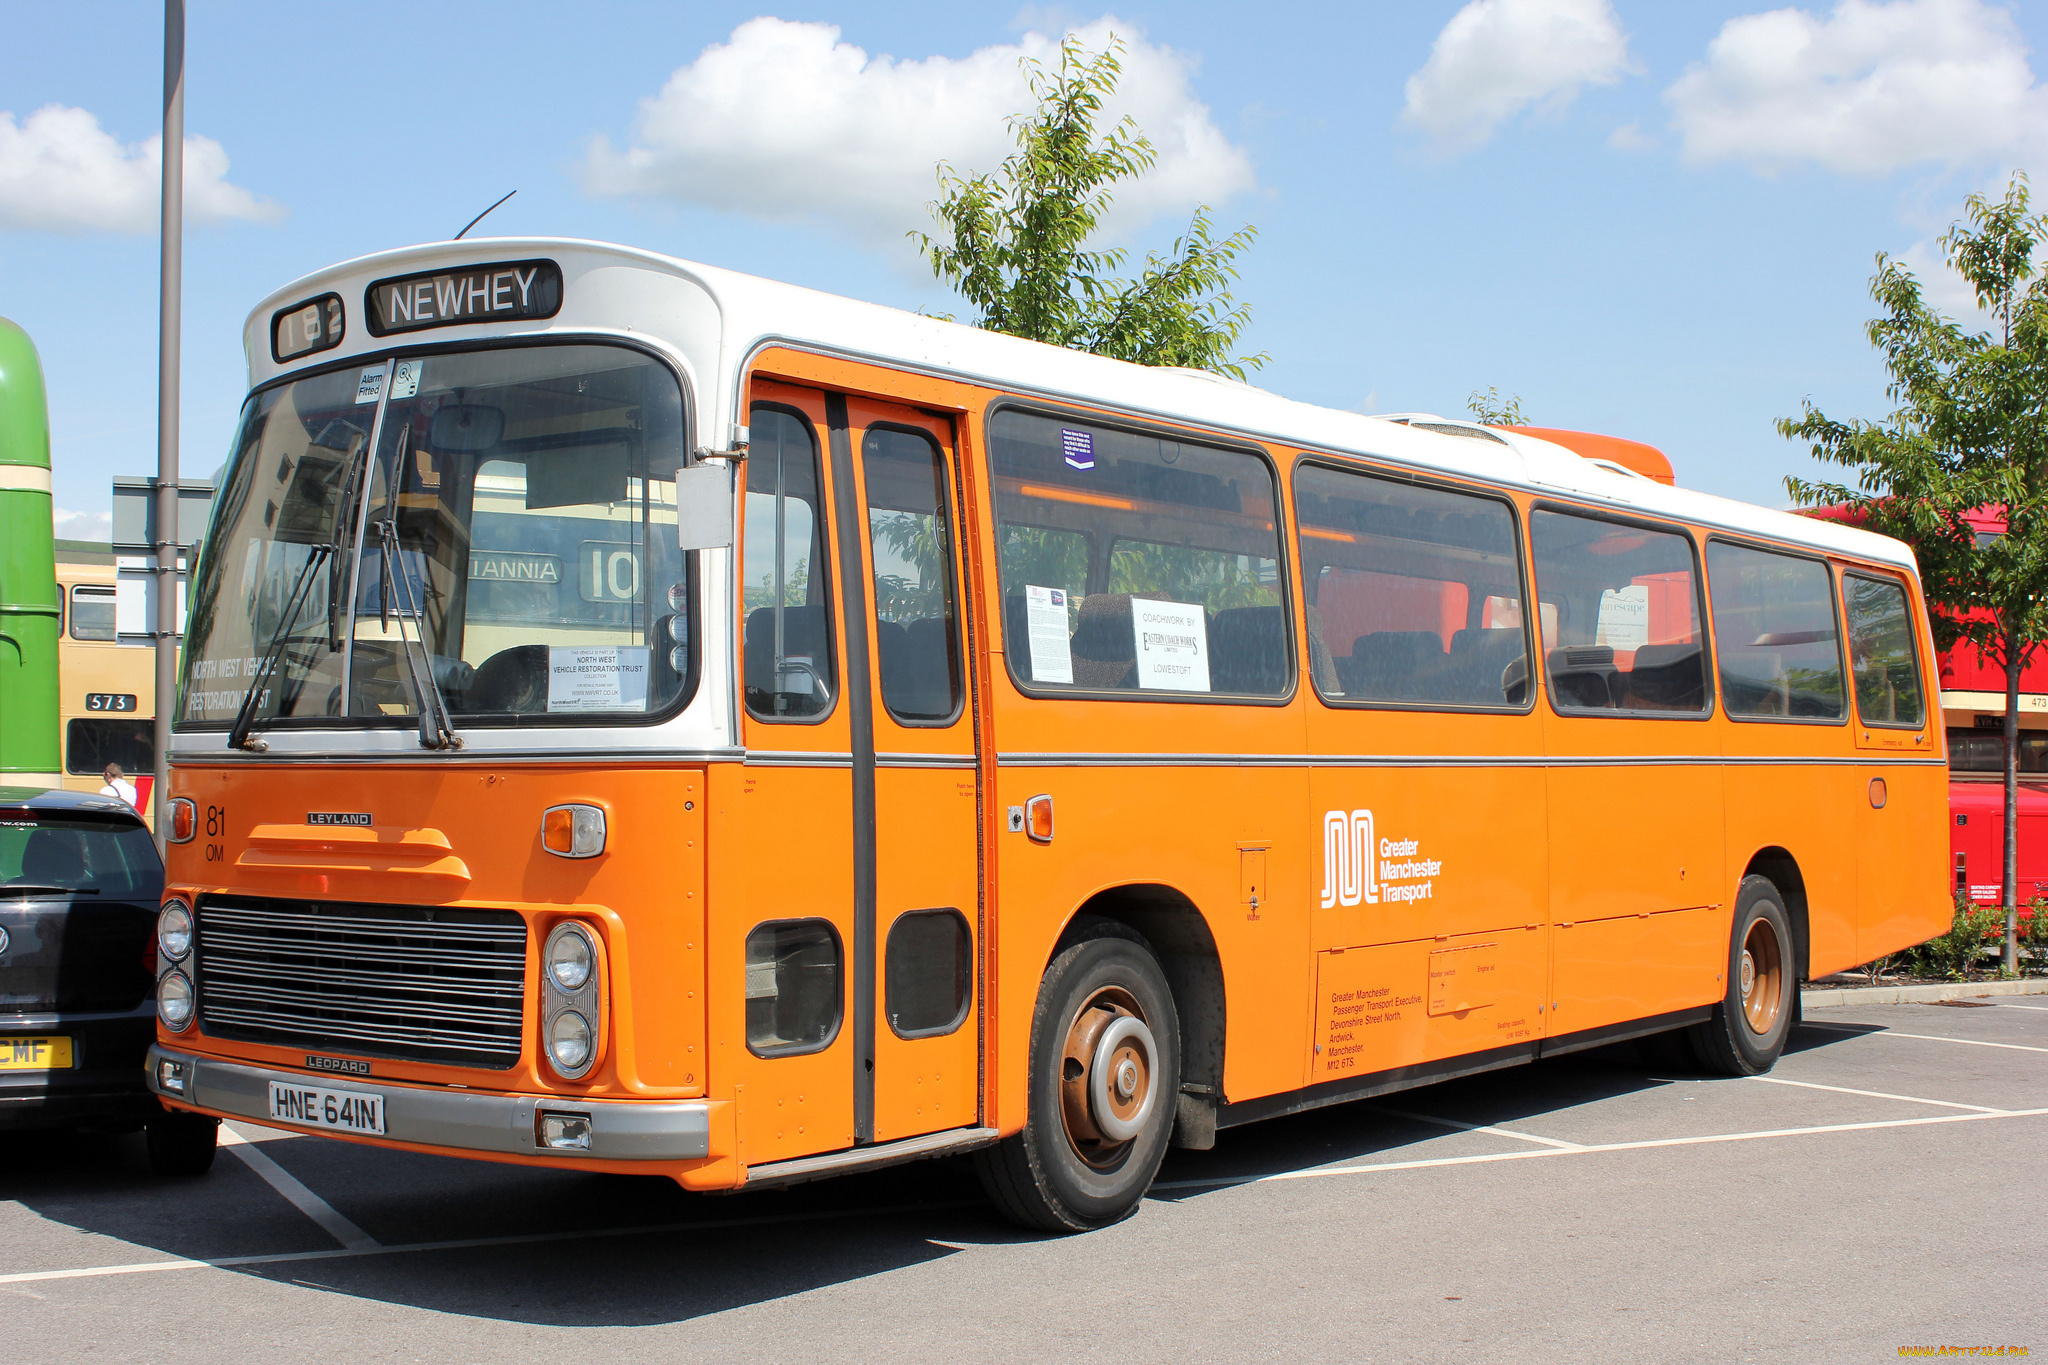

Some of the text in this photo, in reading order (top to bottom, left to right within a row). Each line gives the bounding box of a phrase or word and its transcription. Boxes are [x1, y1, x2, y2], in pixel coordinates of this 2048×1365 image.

[391, 268, 538, 323] NEWHEY
[361, 373, 383, 385] Alarm
[358, 385, 380, 397] Fitted
[592, 549, 639, 598] 10
[1143, 613, 1195, 626] COACHWORK BY
[191, 660, 218, 679] NORTH
[219, 658, 241, 677] WEST
[1154, 664, 1191, 675] LOWESTOFT
[91, 695, 126, 710] 573
[190, 690, 241, 711] RESTORATION
[2032, 698, 2047, 707] 473
[1975, 716, 1992, 727] KVH
[206, 806, 224, 836] 81
[310, 814, 368, 825] LEYLAND
[206, 844, 224, 862] OM
[1380, 838, 1418, 858] Greater
[1380, 858, 1442, 880] Manchester
[1380, 880, 1432, 905] Transport
[1332, 988, 1390, 1003] Greater Manchester
[1334, 995, 1422, 1015] Passenger Transport Executive,
[1331, 1018, 1363, 1030] Devonshire
[1365, 1014, 1382, 1025] Street
[309, 1056, 367, 1073] LEOPARD
[1327, 1061, 1339, 1071] M12
[276, 1088, 318, 1121] HNE
